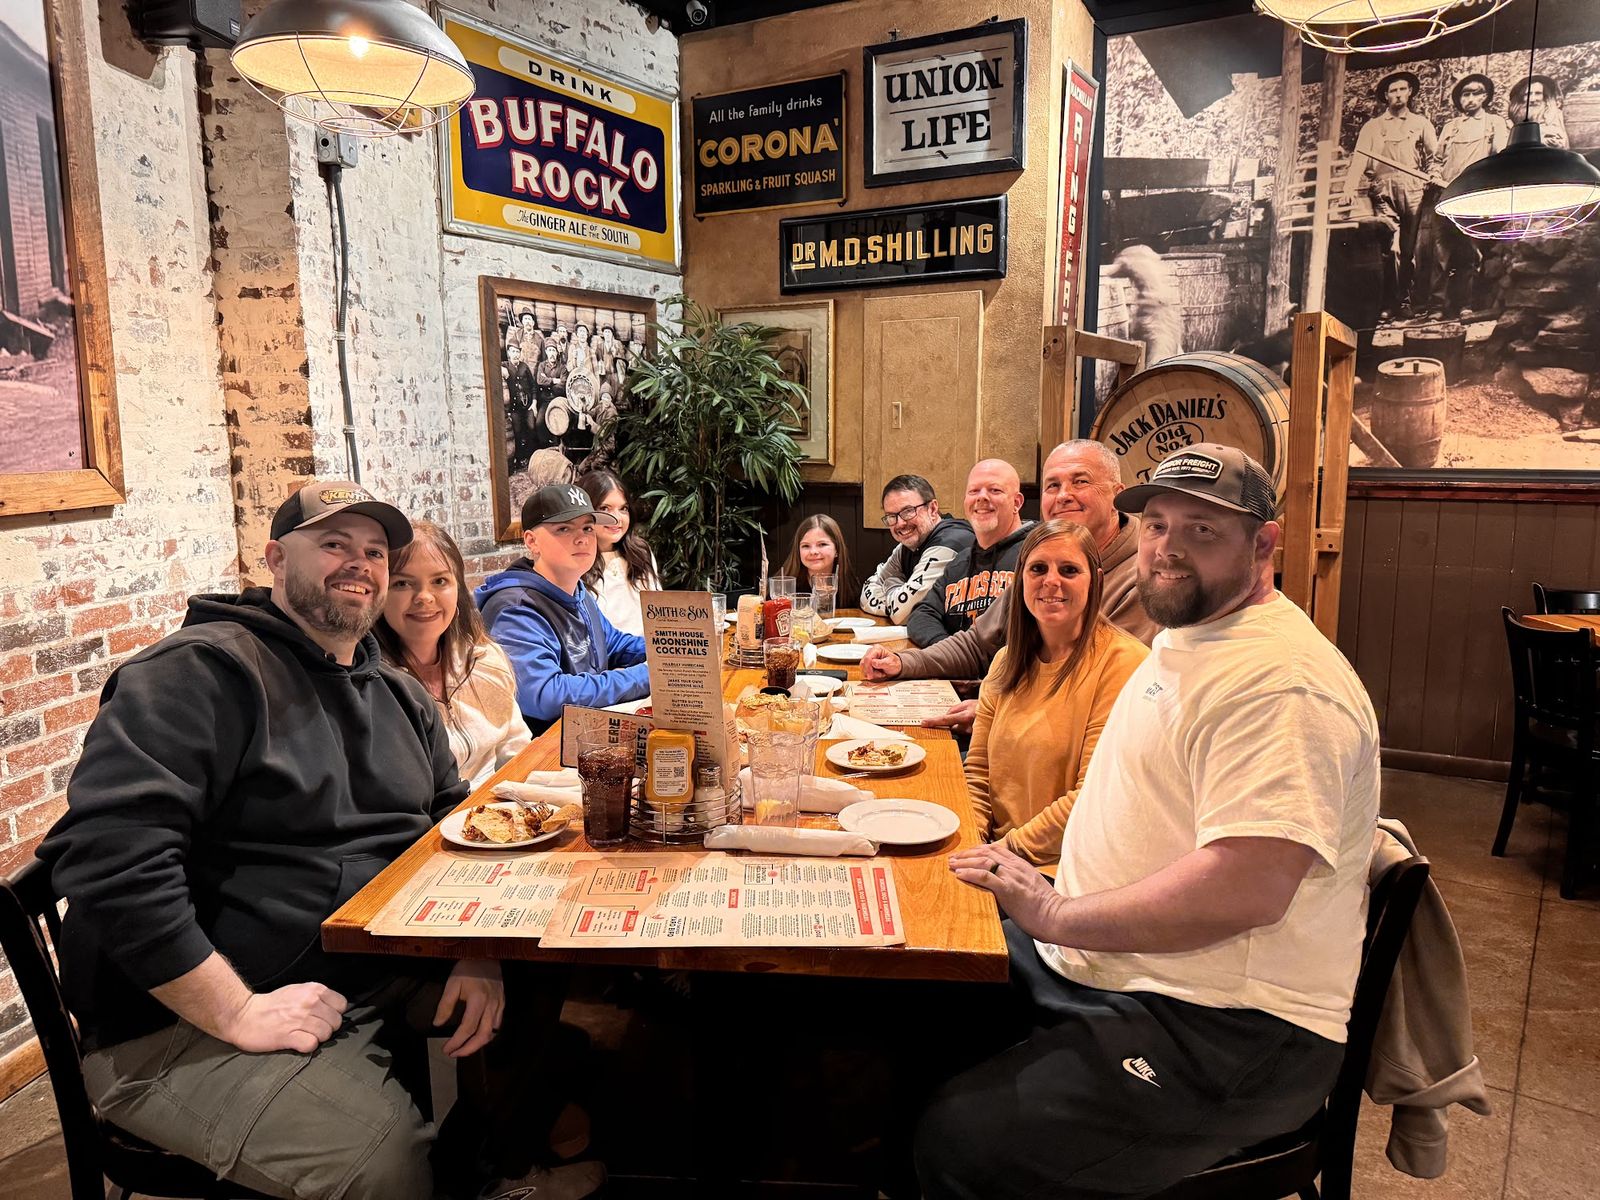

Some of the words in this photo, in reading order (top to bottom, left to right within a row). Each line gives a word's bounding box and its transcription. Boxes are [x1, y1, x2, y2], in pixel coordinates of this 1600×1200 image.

[528, 59, 613, 104] DRINK
[883, 57, 1004, 104] UNION
[709, 109, 724, 124] All
[728, 107, 745, 121] the
[749, 101, 782, 118] family
[787, 94, 822, 111] drinks
[468, 97, 658, 193] BUFFALO
[901, 109, 991, 152] LIFE
[510, 149, 631, 219] ROCK
[701, 179, 753, 197] SPARKLING
[755, 180, 761, 190] &
[763, 174, 791, 189] FRUIT
[794, 169, 836, 186] SQUASH
[529, 212, 566, 233] GINGER
[569, 218, 587, 237] ALE
[601, 229, 629, 245] SOUTH
[792, 241, 816, 262] DR
[1109, 414, 1153, 456] JACK
[1148, 393, 1227, 426] DANIEL'S
[1155, 424, 1187, 443] Old
[1182, 459, 1218, 471] FREIGHT
[679, 607, 686, 618] &
[687, 605, 709, 621] SON
[652, 637, 709, 647] MOONSHINE
[655, 646, 708, 656] COCKTAILS
[636, 728, 647, 768] MEETS
[1131, 1056, 1157, 1078] NIKE
